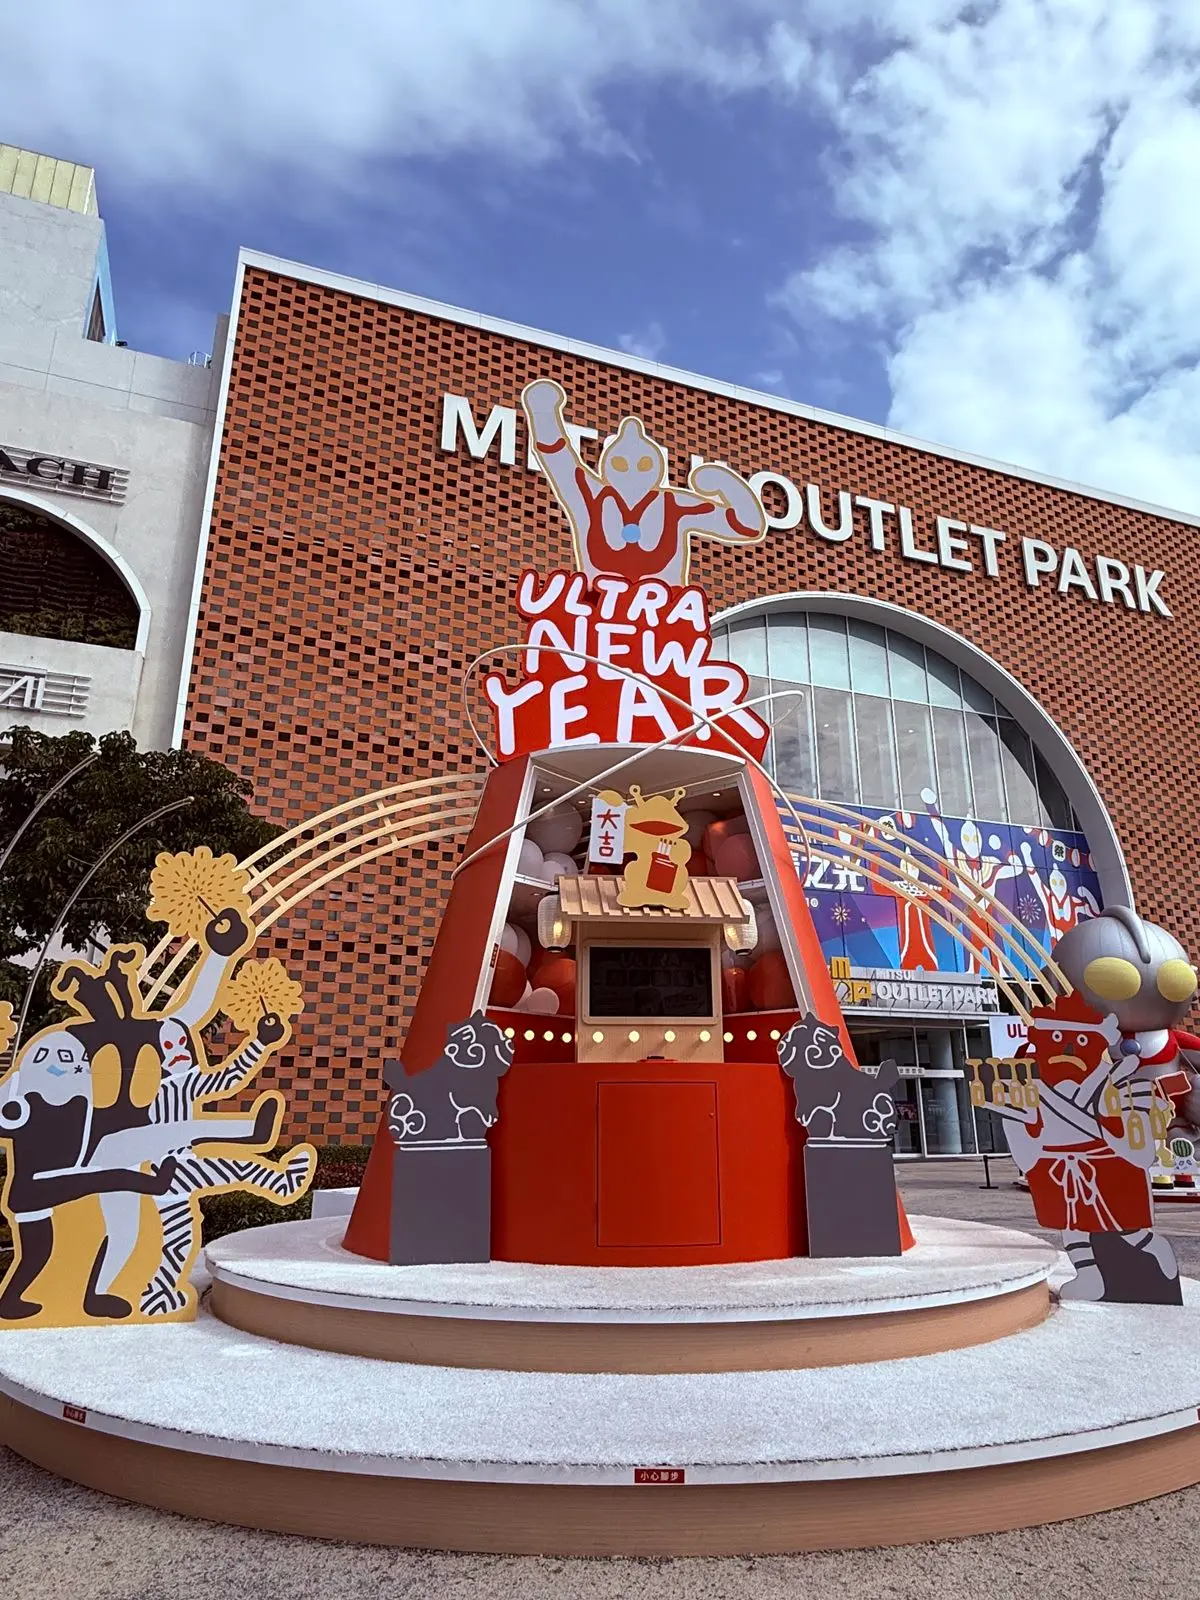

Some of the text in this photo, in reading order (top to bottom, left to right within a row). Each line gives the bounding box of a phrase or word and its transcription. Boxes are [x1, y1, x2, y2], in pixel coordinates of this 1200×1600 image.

[748, 471, 1174, 619] OUTLET PARK
[519, 573, 706, 632] ULTRA
[525, 615, 708, 681] NEW
[485, 665, 766, 756] YEAR
[596, 808, 621, 857] 大吉
[876, 981, 997, 1005] OUTLET PARK
